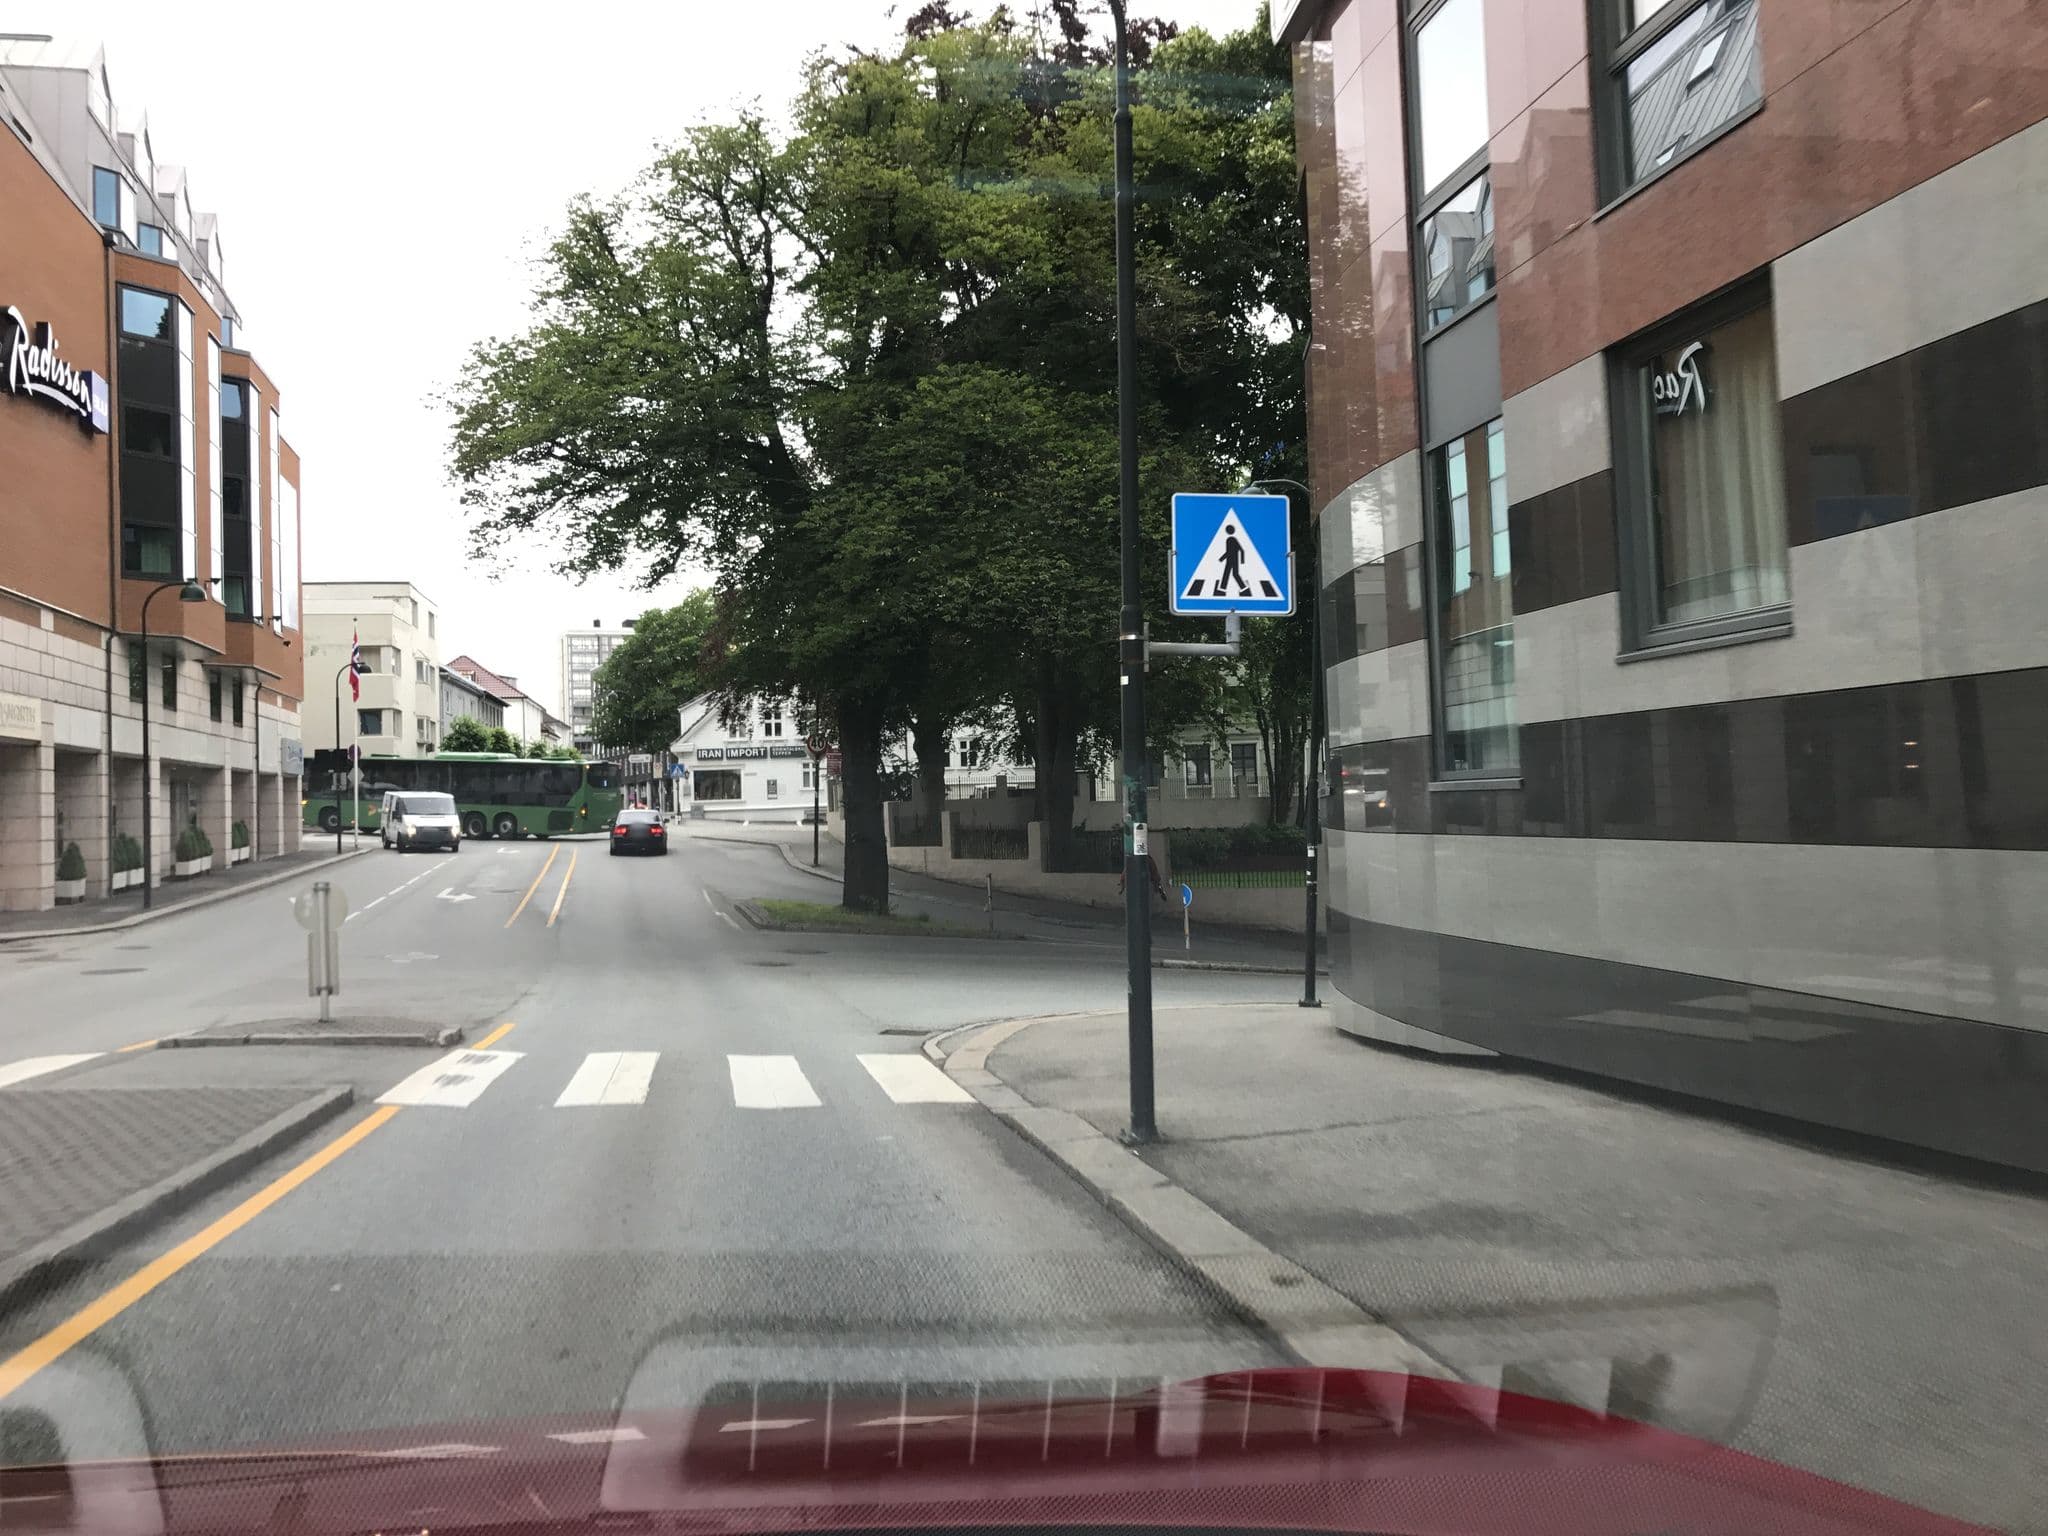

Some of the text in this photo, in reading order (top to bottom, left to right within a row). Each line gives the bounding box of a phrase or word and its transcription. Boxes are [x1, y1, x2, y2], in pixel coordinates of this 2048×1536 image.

[8, 305, 91, 413] Radisson
[811, 736, 824, 749] 40
[698, 749, 722, 758] IRAN
[727, 748, 766, 757] IMPORT
